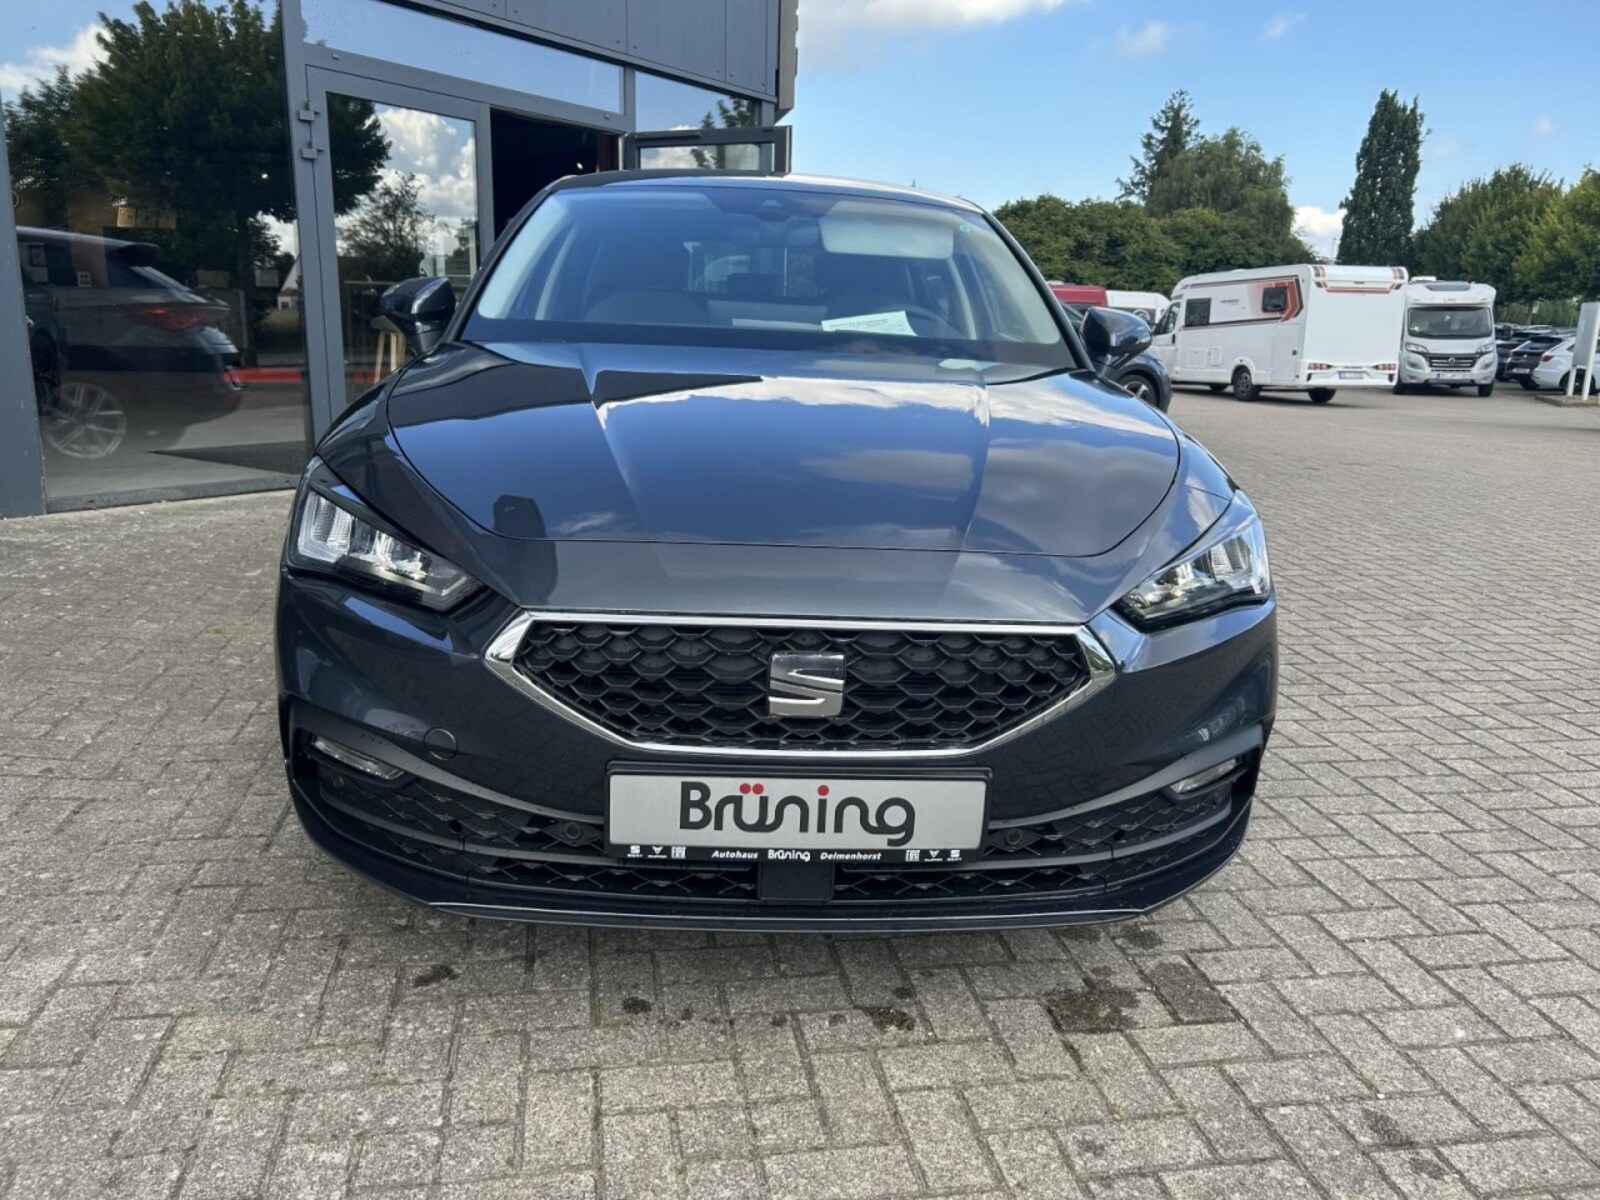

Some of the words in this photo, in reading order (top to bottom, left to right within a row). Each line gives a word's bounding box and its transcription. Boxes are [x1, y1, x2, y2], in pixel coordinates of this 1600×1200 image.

[679, 781, 916, 847] Brüning
[711, 850, 759, 859] Autohaus
[767, 849, 811, 862] Brüning
[820, 852, 882, 860] Delmenhorst
